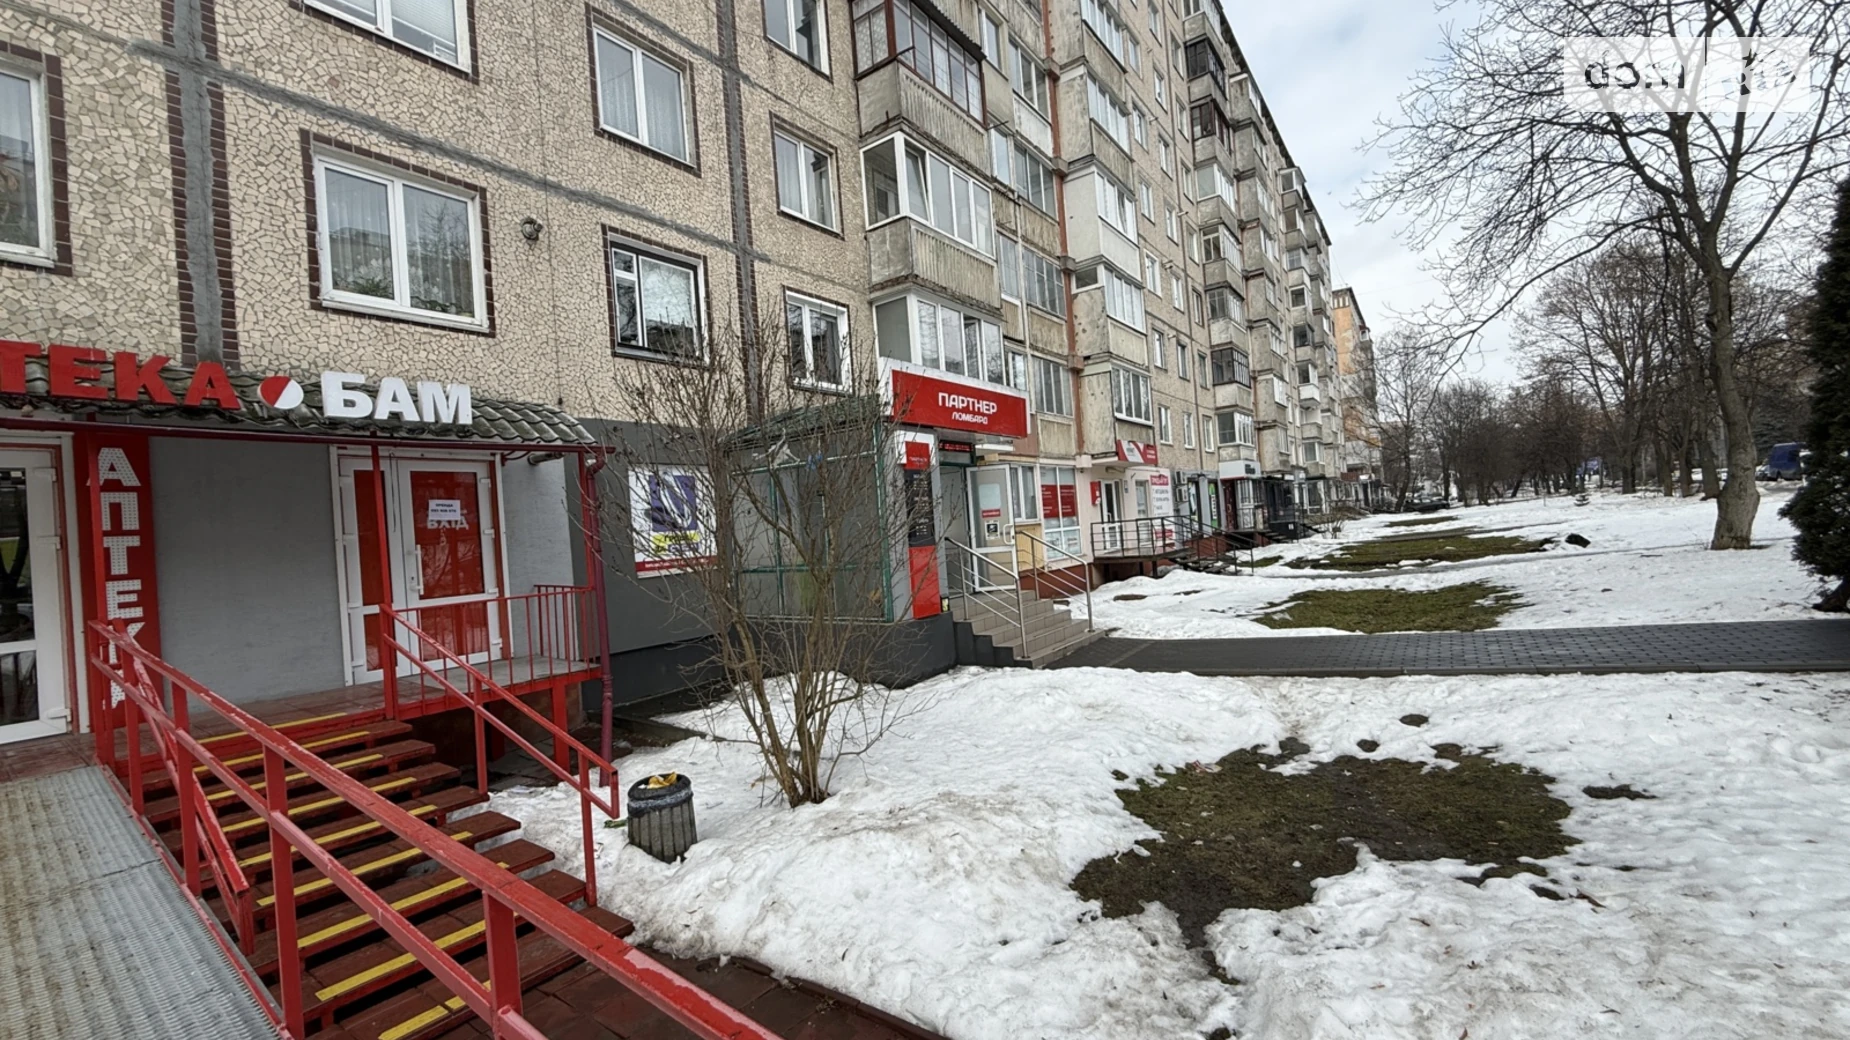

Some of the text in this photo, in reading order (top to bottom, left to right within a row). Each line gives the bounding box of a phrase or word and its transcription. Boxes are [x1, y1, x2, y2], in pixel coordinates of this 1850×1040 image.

[0, 340, 473, 425] ТЕКА БАМ
[938, 392, 998, 415] ПАРТНЕР
[951, 411, 989, 425] ЛОМБАРД
